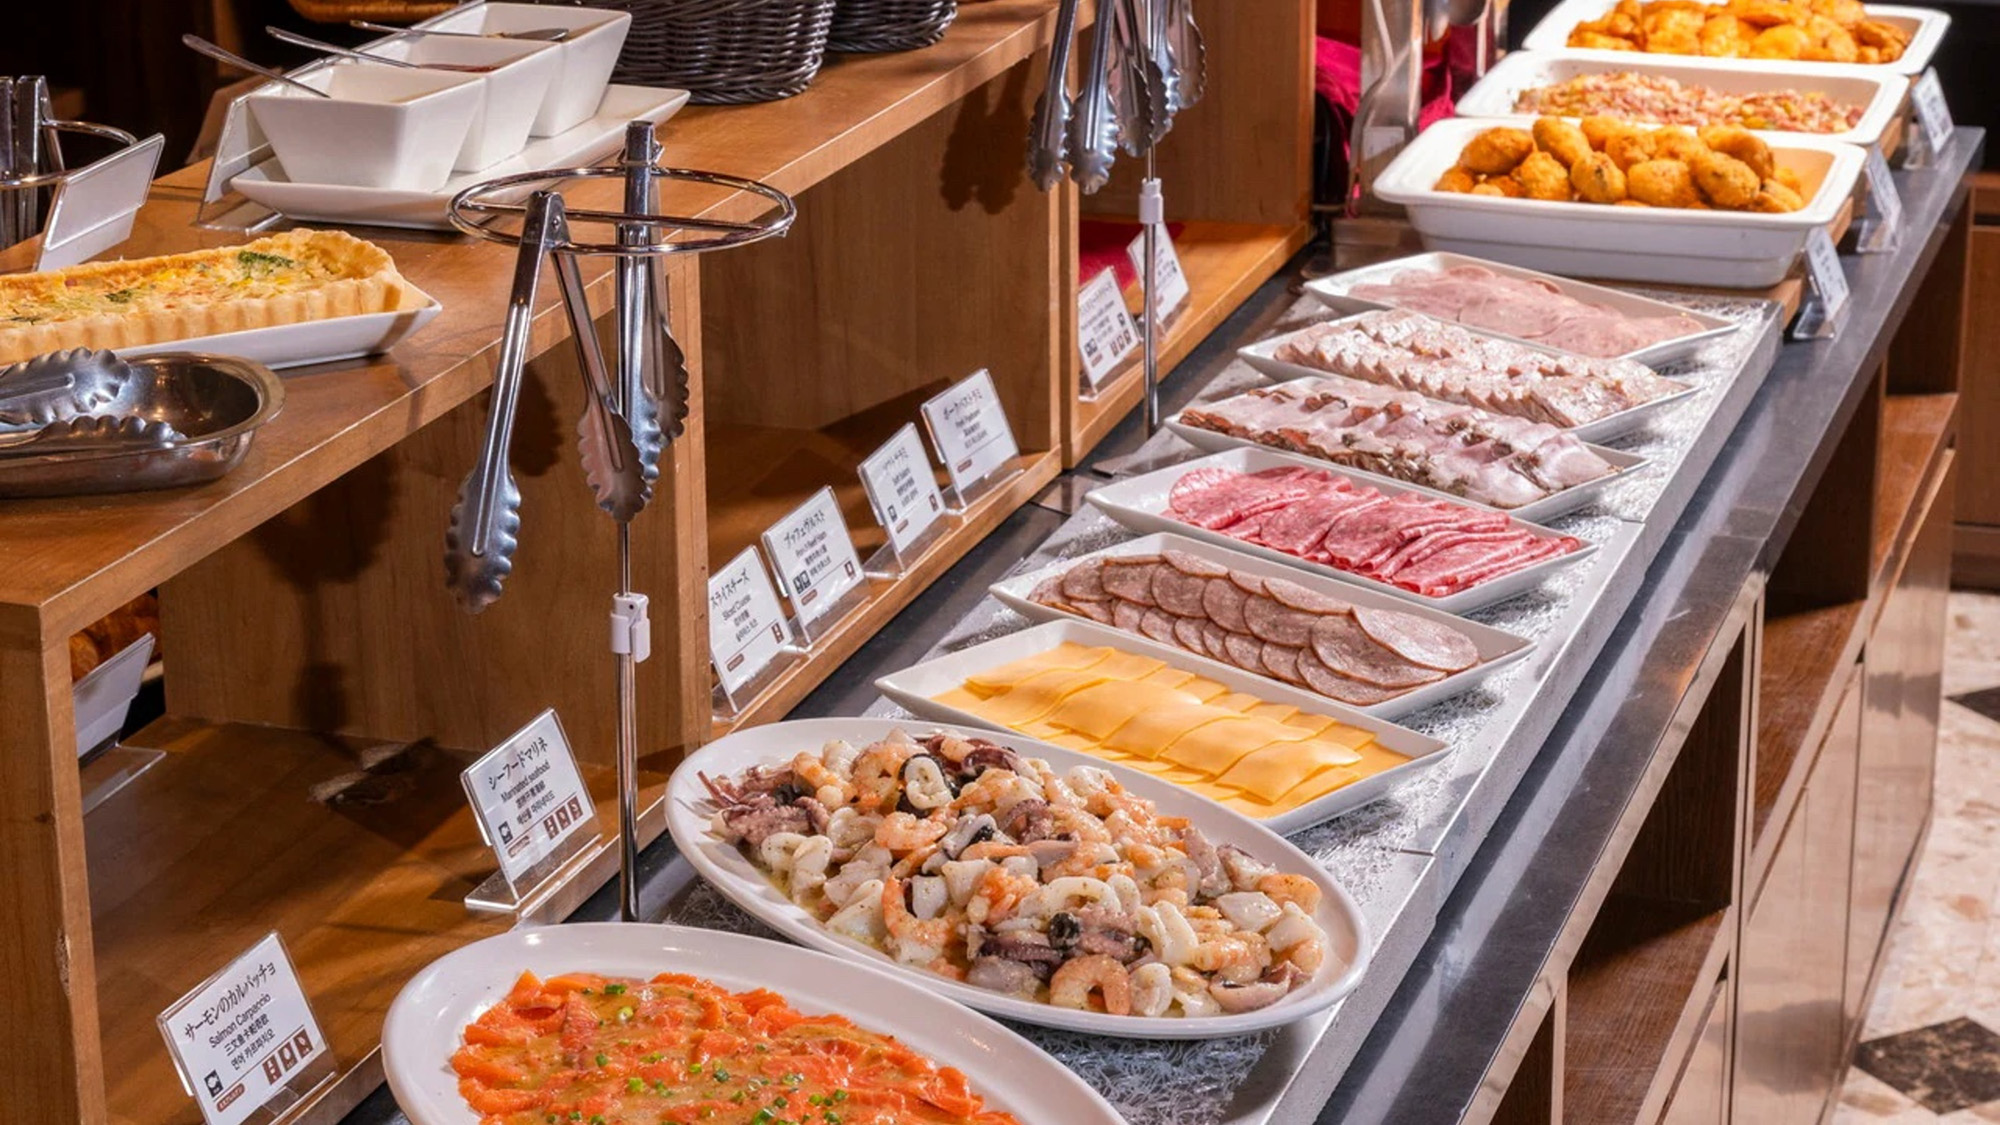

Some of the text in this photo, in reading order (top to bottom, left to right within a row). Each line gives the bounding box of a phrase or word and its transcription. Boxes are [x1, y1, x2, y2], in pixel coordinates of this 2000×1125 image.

[710, 567, 750, 610] スライスチーズ
[488, 736, 549, 791] シーフードマリネ
[501, 775, 530, 804] Marinated
[528, 761, 550, 784] seafood
[184, 962, 276, 1042] サーモンのカルパッチョ
[209, 993, 271, 1049] Salmon Carpaccio
[231, 1052, 246, 1071] 연어
